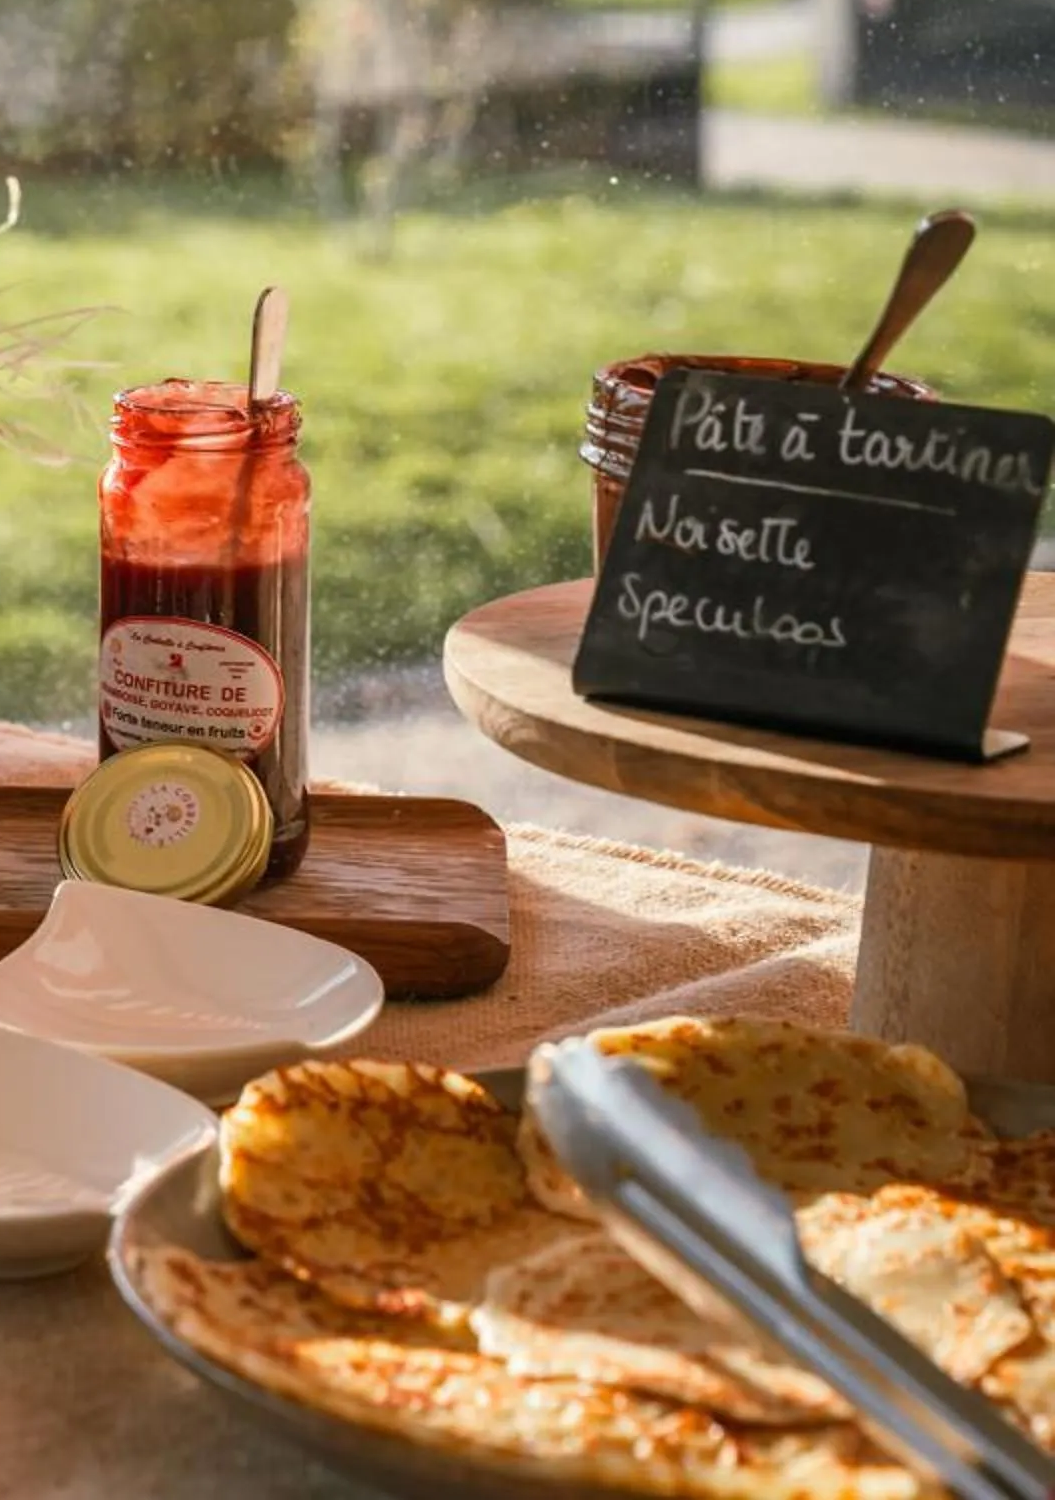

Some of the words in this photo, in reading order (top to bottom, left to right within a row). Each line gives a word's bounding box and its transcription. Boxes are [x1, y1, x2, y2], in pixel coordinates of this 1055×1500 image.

[668, 382, 766, 454] Pâte
[780, 412, 819, 461] à
[635, 495, 817, 570] Noisette
[617, 572, 847, 647] Speculoos
[112, 707, 138, 726] Forte
[141, 714, 184, 734] teneur
[187, 723, 206, 738] en
[208, 723, 246, 740] fruits
[114, 669, 212, 701] CONFITURE
[221, 687, 247, 703] DE
